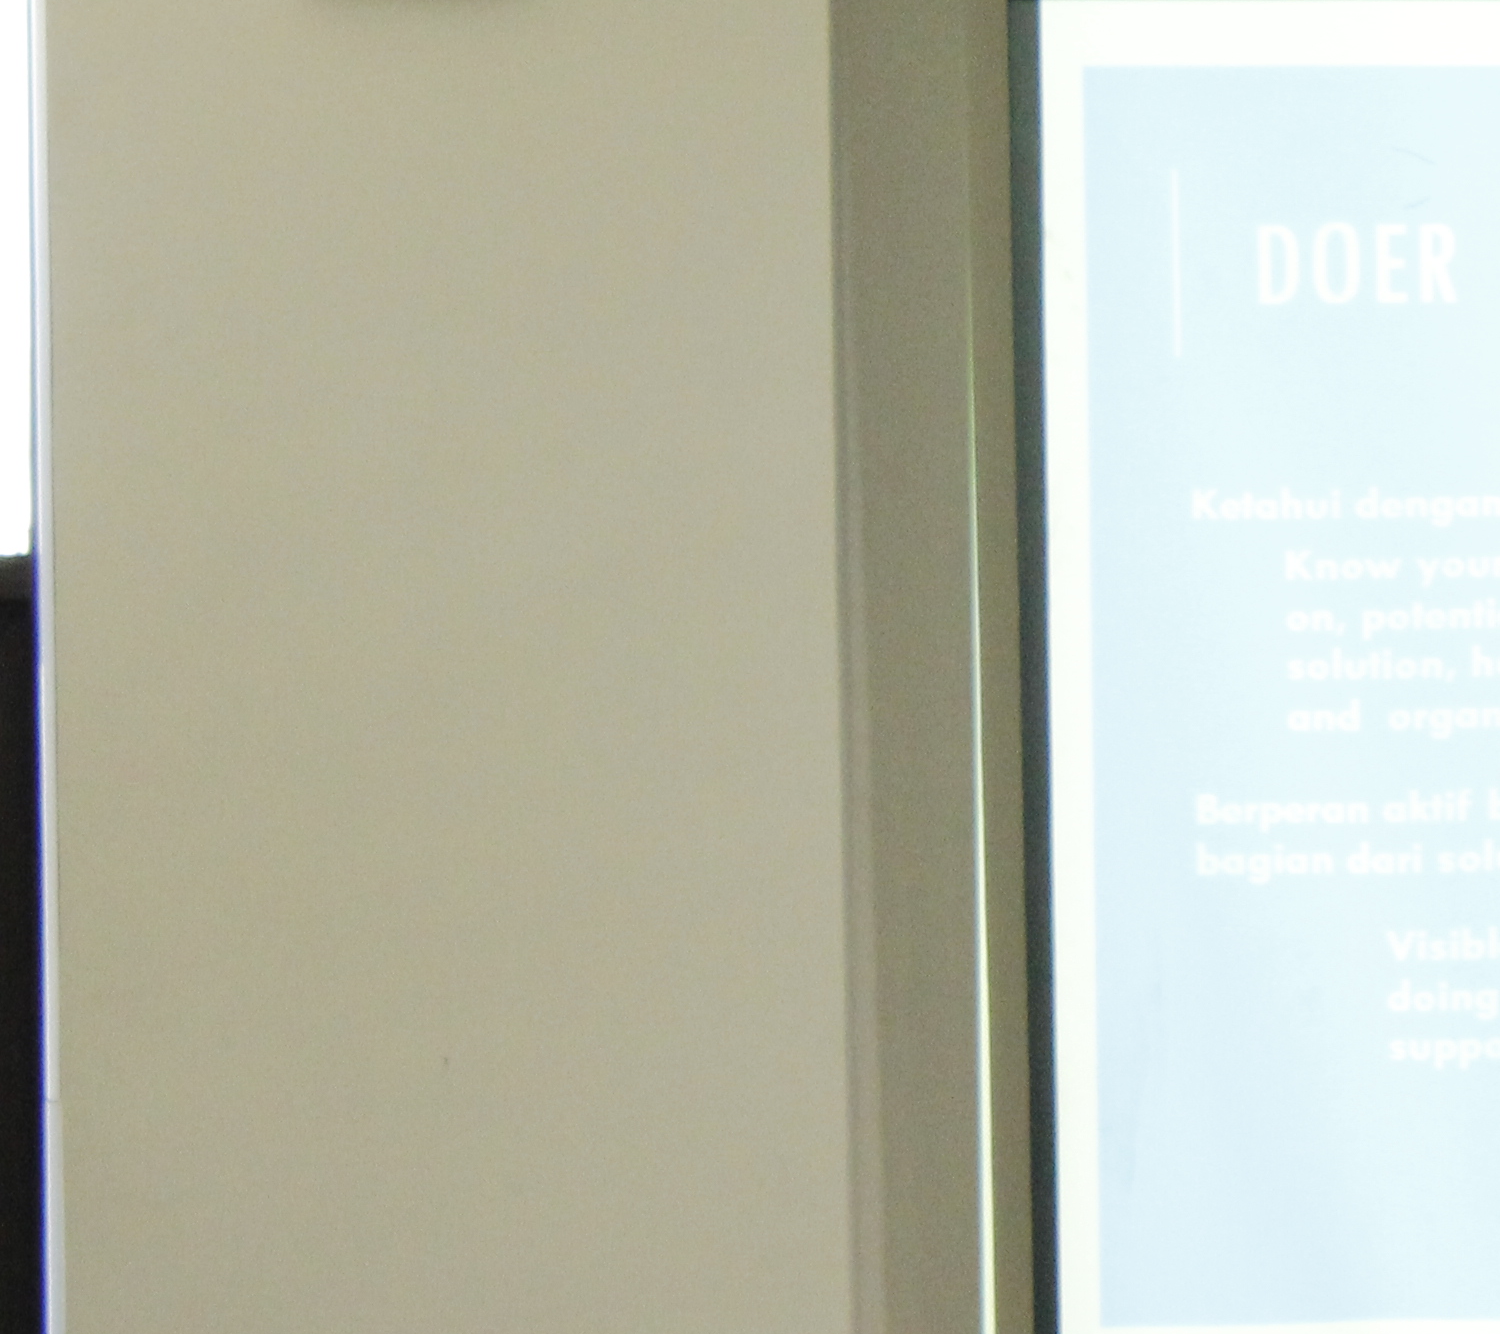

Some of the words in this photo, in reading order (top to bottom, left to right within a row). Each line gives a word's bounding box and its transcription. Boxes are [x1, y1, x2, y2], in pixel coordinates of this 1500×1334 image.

[1257, 221, 1458, 306] DOER
[1191, 486, 1341, 521] Ketahui
[1284, 549, 1402, 581] Know
[1285, 609, 1346, 636] on,
[1286, 646, 1456, 682] solution,
[1286, 698, 1361, 732] and
[1196, 793, 1370, 833] Berperan
[1381, 788, 1472, 824] aktif
[1196, 843, 1336, 886] bagian
[1345, 840, 1422, 875] dari
[1386, 977, 1499, 1021] doing
